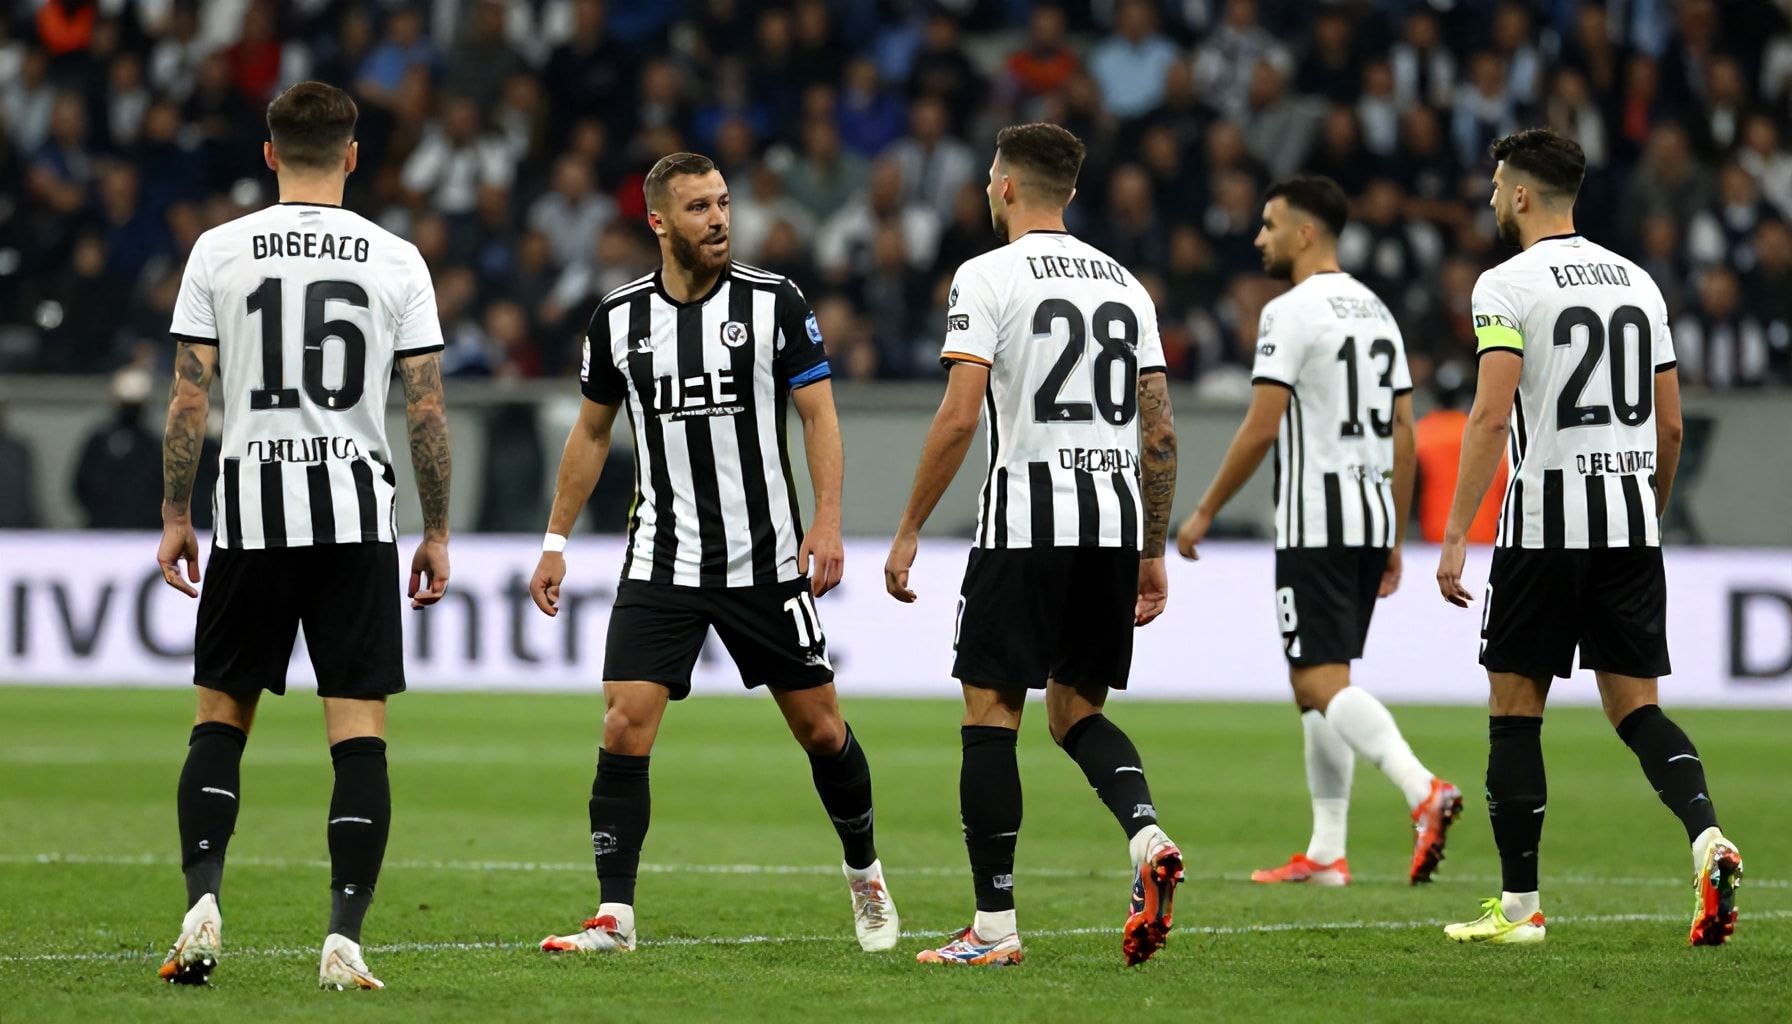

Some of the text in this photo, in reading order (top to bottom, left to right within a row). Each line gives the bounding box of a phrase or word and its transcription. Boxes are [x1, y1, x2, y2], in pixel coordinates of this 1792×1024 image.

[246, 277, 369, 411] 16
[1033, 299, 1139, 426] 28
[1337, 336, 1396, 438] 13
[1553, 305, 1652, 432] 20
